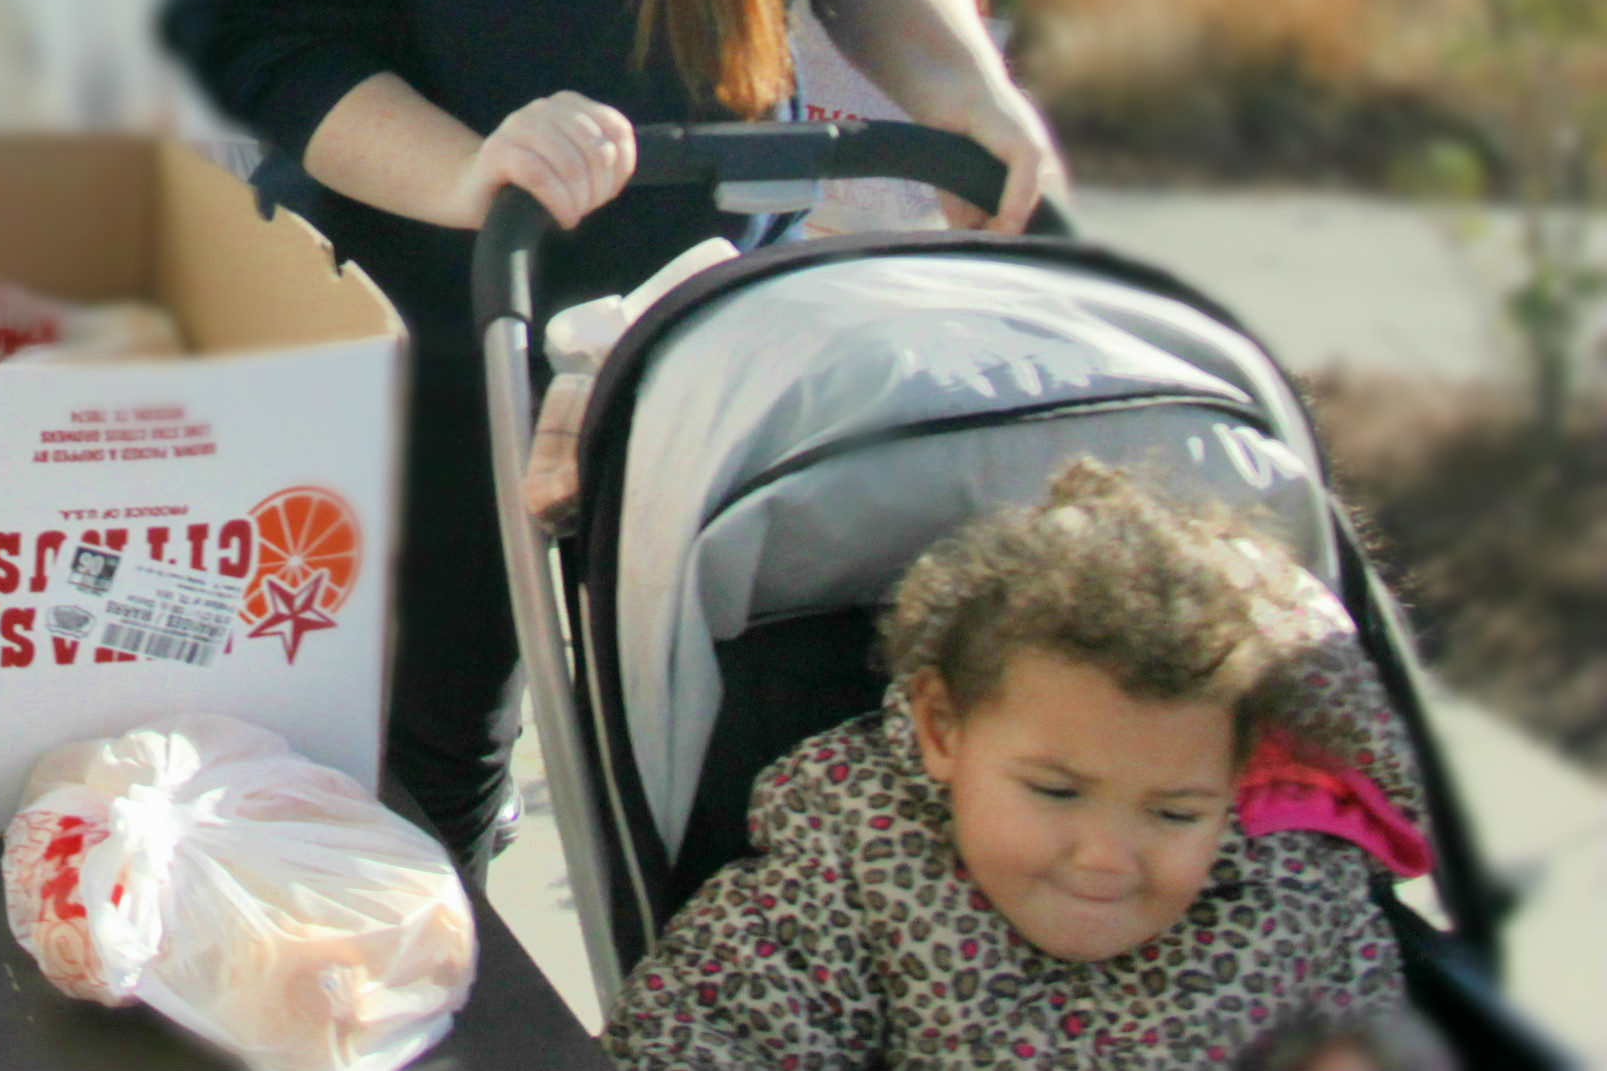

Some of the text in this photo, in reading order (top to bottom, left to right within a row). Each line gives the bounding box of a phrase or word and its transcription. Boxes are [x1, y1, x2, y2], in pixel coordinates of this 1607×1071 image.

[32, 451, 50, 463] BY
[102, 508, 120, 519] OF
[124, 505, 189, 518] PRODUCE
